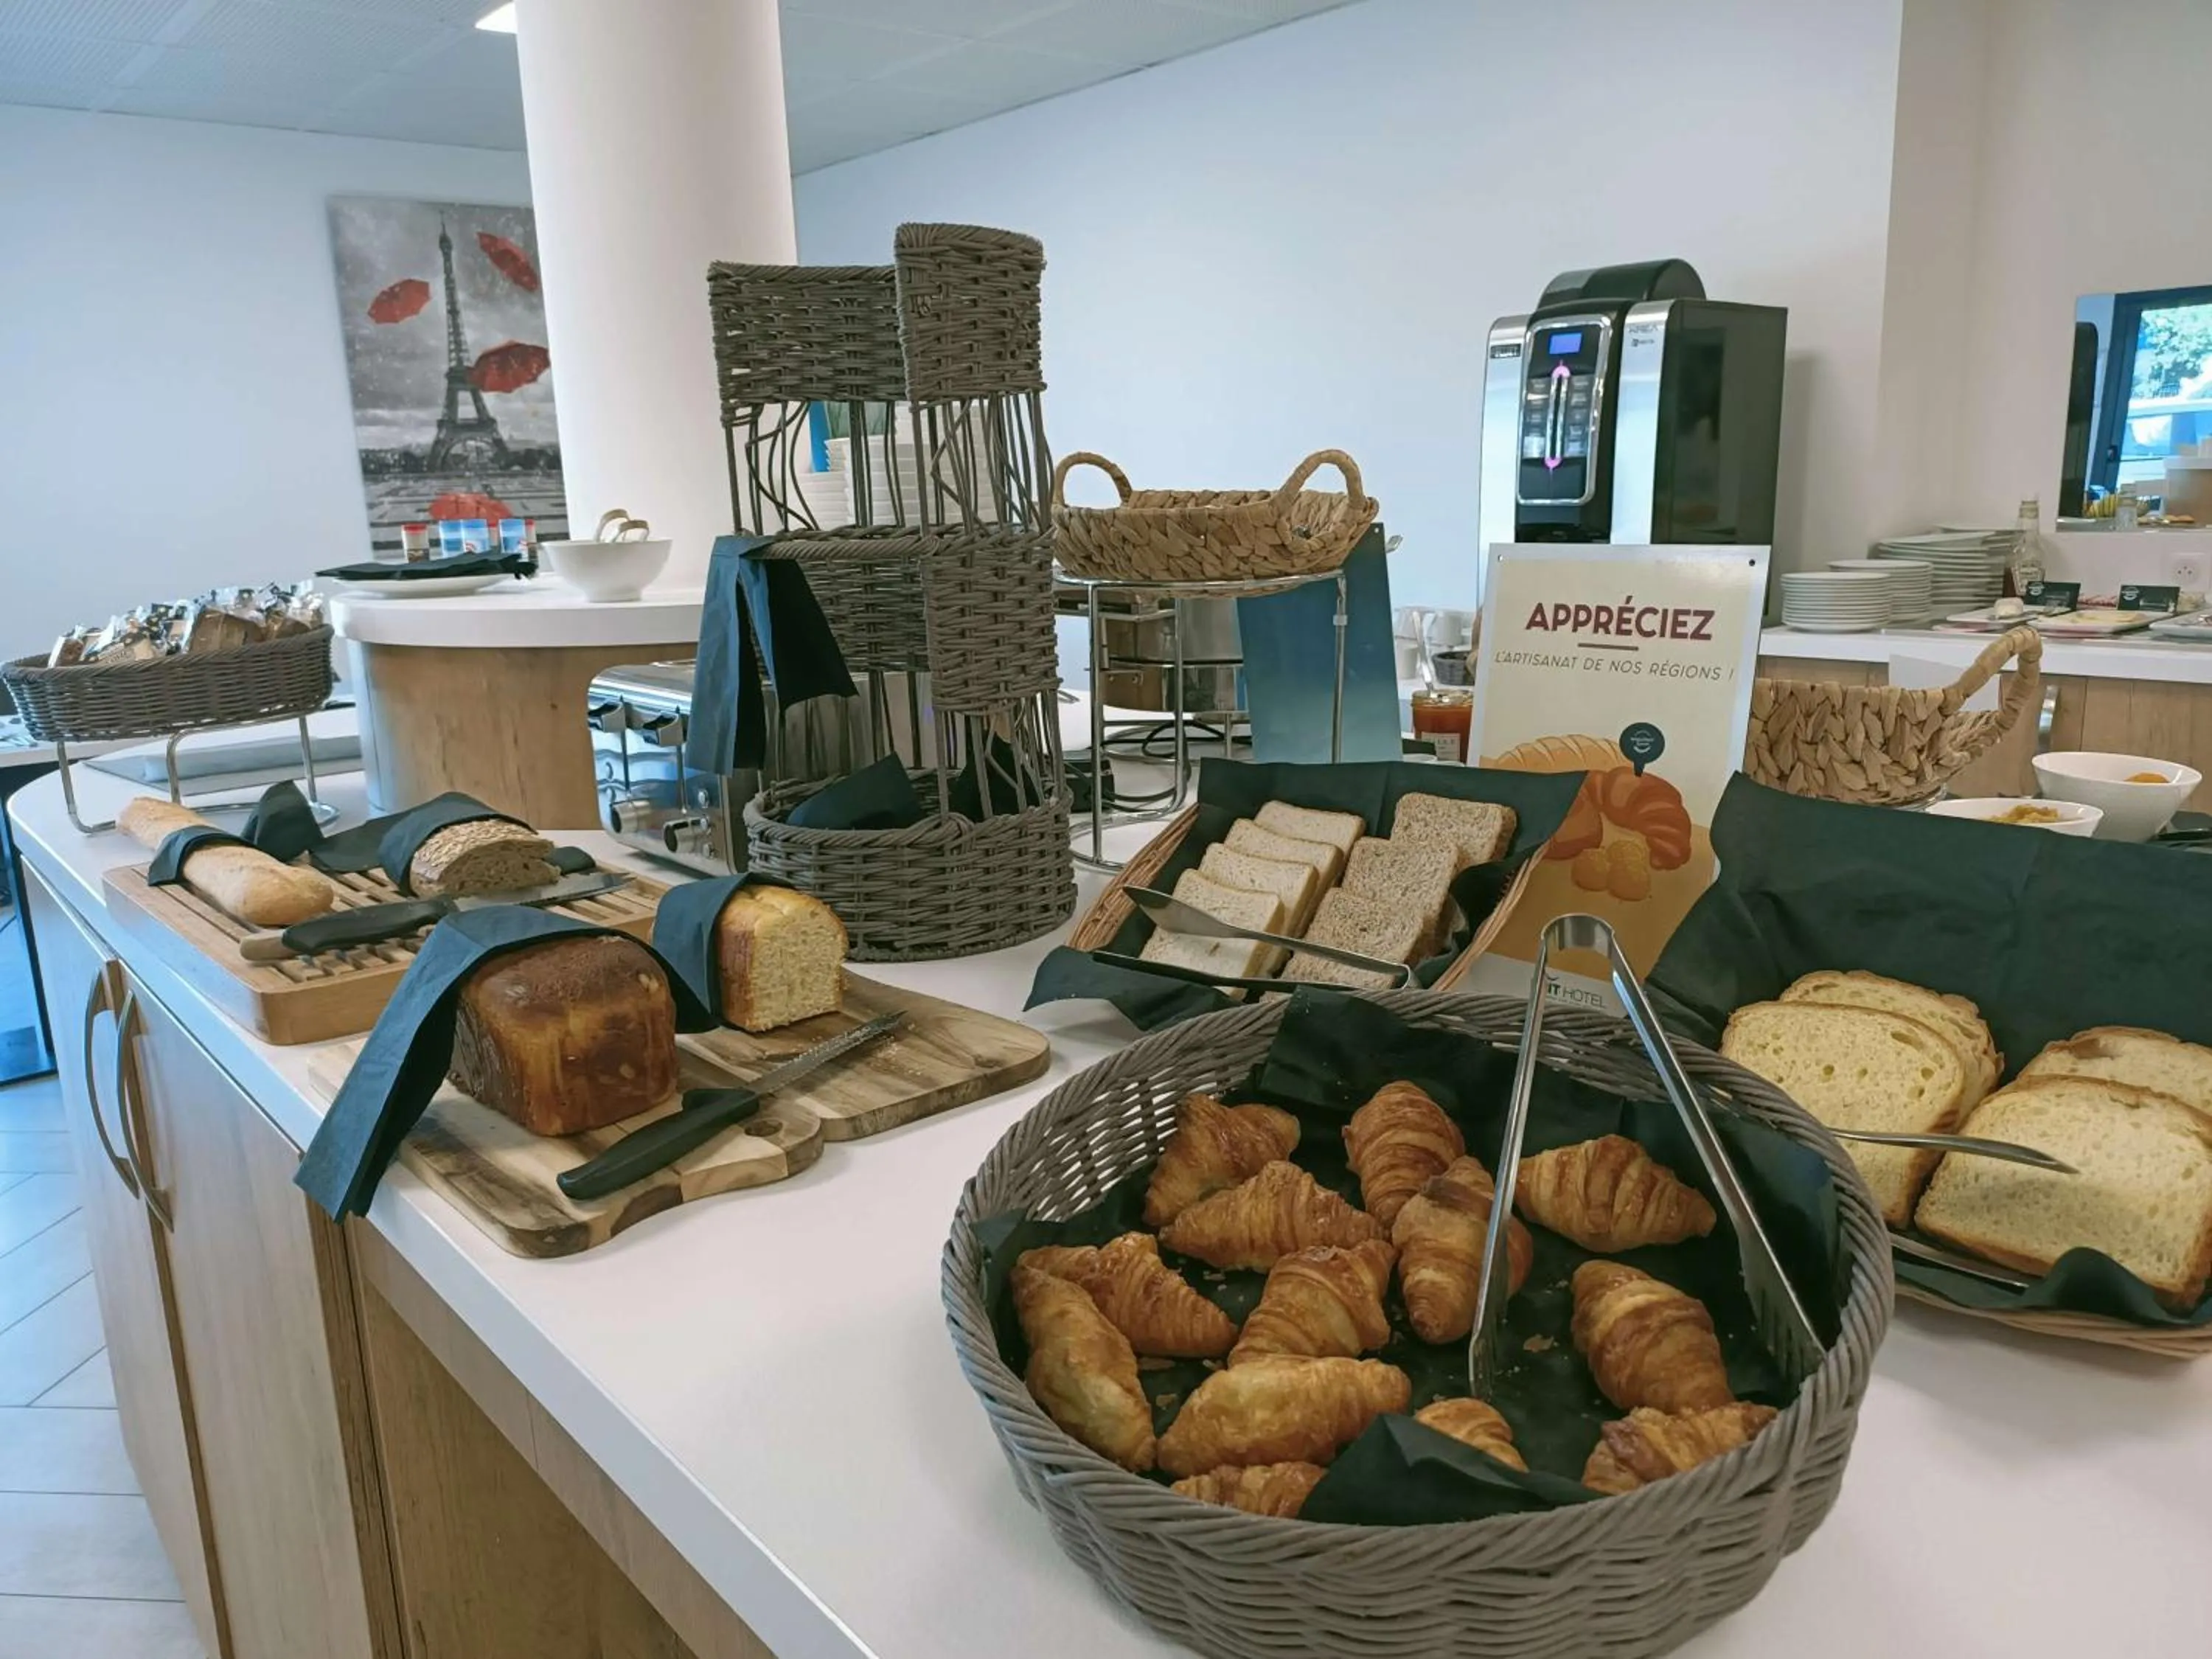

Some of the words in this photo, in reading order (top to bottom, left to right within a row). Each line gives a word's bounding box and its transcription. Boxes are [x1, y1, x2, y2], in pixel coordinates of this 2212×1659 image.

[1525, 595, 1716, 641] APPRÉCIEZ
[1495, 650, 1579, 669] L'ARTISANAT
[1582, 658, 1605, 672] DE
[1609, 659, 1643, 675] NOS
[1649, 660, 1722, 681] RÉGIONS
[1562, 988, 1607, 1009] HOTEL
